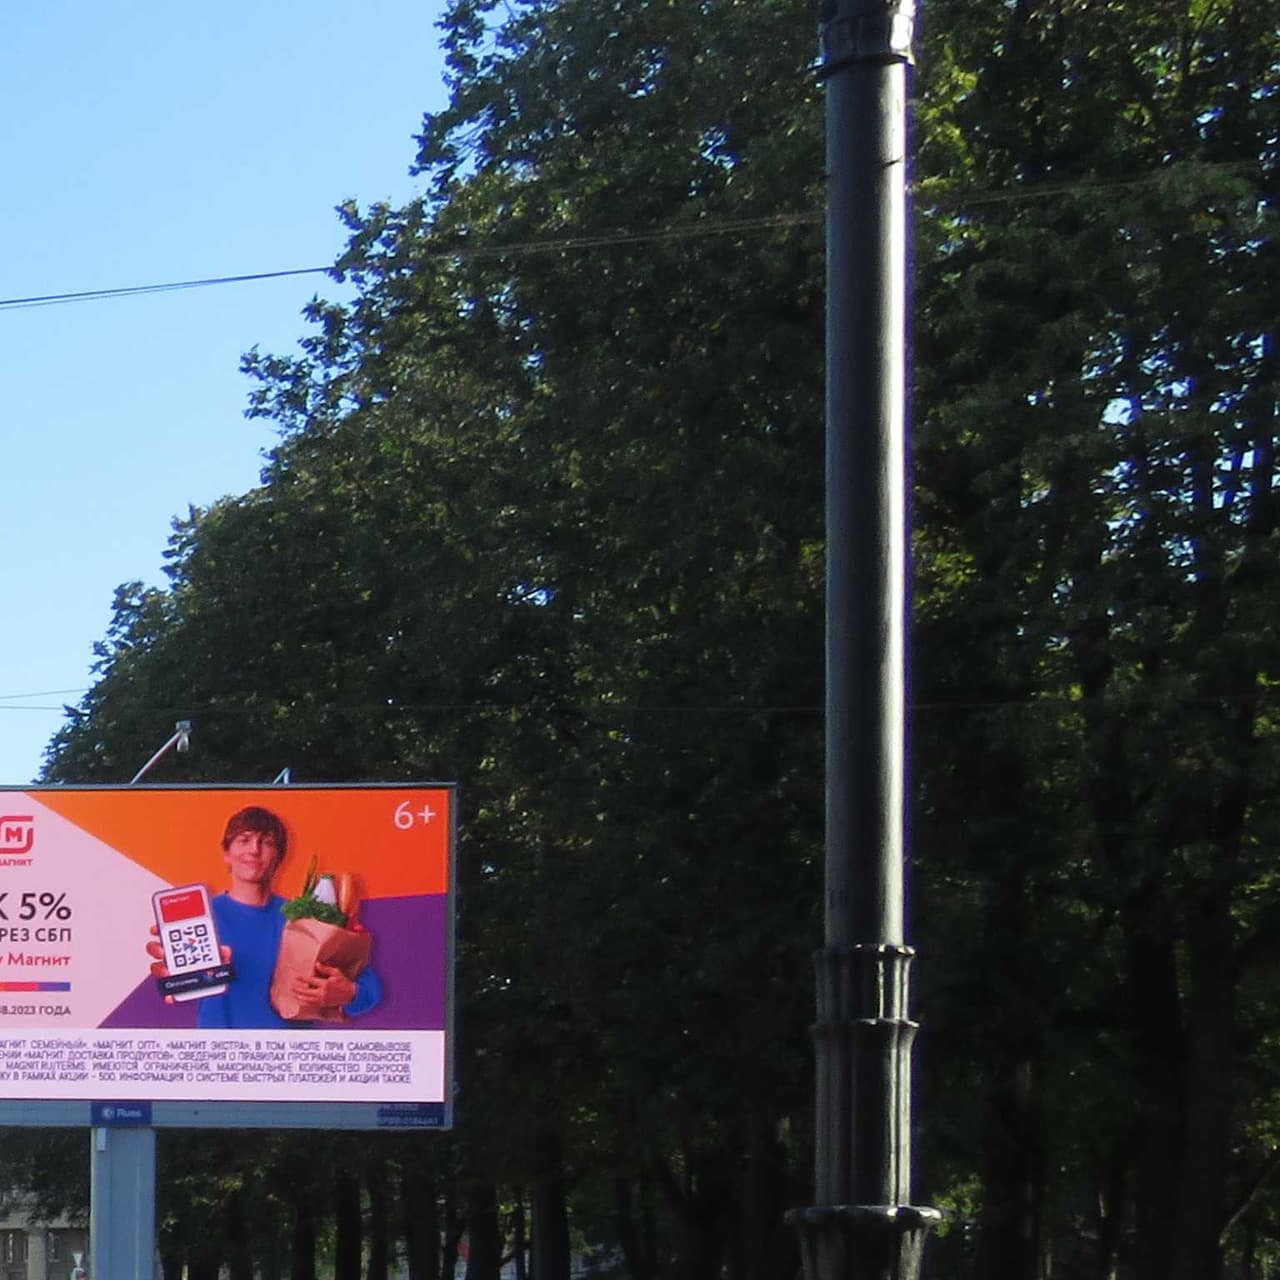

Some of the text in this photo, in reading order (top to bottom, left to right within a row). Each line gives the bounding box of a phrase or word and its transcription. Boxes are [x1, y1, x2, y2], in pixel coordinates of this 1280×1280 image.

[394, 799, 436, 829] 6+
[19, 892, 72, 920] 5%
[34, 927, 72, 942] СБП
[7, 953, 71, 967] Магнит
[38, 1005, 71, 1014] ГОДА
